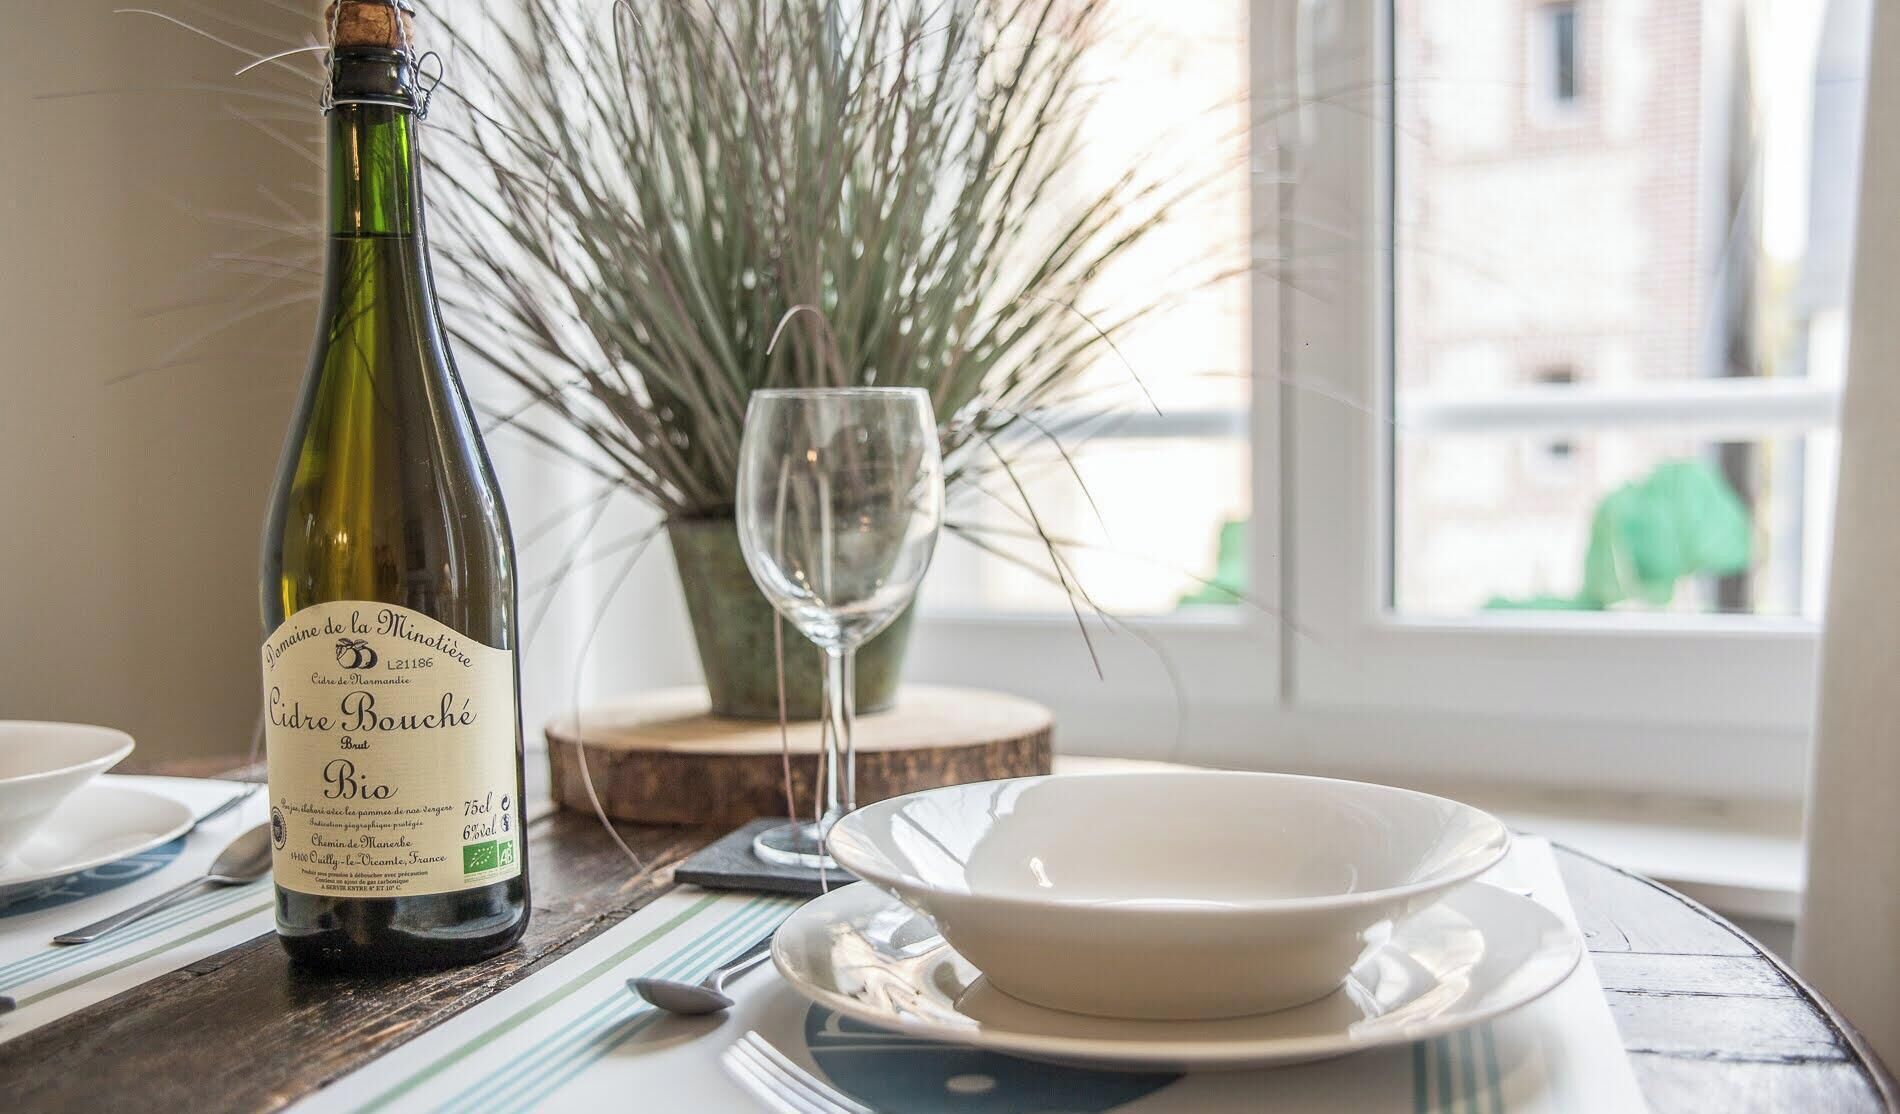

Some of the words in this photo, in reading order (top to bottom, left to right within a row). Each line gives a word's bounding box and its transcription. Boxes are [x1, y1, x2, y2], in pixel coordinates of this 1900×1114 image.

[266, 625, 320, 671] Domaine
[324, 616, 346, 635] de
[351, 610, 372, 633] la
[377, 609, 473, 667] Minotière
[387, 658, 433, 670] L21186
[311, 672, 336, 685] Cidre
[337, 676, 348, 685] de
[350, 672, 412, 685] Normandie
[269, 686, 335, 730] Cidre
[341, 690, 477, 731] Bouché
[340, 736, 370, 750] Brut
[323, 758, 399, 799] Bio
[464, 791, 492, 816] 75cl
[326, 806, 344, 816] avec
[344, 805, 357, 816] les
[358, 807, 393, 819] pommes
[394, 806, 405, 815] de
[422, 805, 454, 816] vergers
[311, 832, 346, 848] Chemin
[347, 839, 360, 849] de
[360, 834, 413, 849] Manerbe
[409, 850, 447, 865] France
